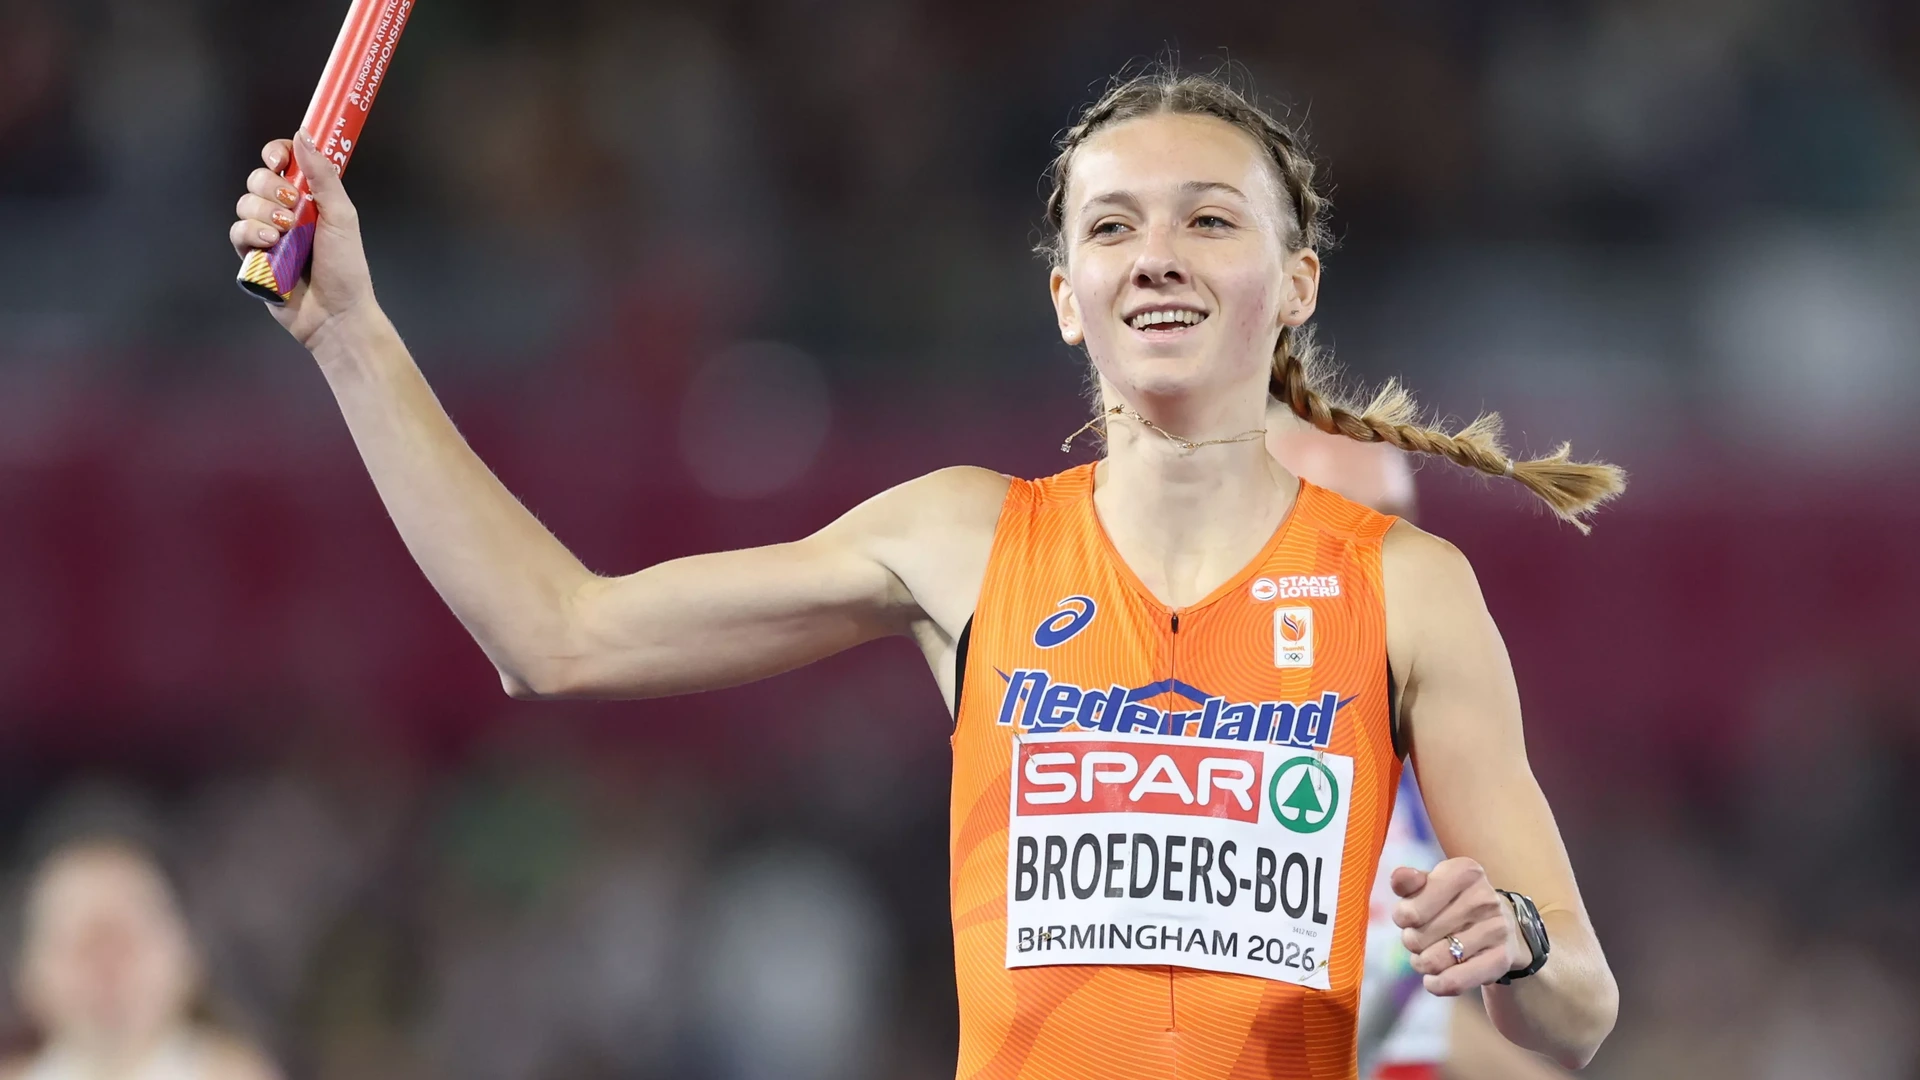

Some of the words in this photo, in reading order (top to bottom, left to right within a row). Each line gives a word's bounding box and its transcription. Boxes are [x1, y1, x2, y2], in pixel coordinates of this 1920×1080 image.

[354, 41, 381, 92] EUROPEAN
[359, 0, 411, 112] CHAMPIONSHIPS
[1278, 575, 1338, 588] STAATS
[1280, 585, 1340, 599] LOTERIJ
[1023, 751, 1256, 811] SPAR
[1014, 832, 1328, 925] BROEDERS-BOL
[1017, 923, 1239, 958] BIRMINGHAM
[1246, 934, 1316, 972] 2026
